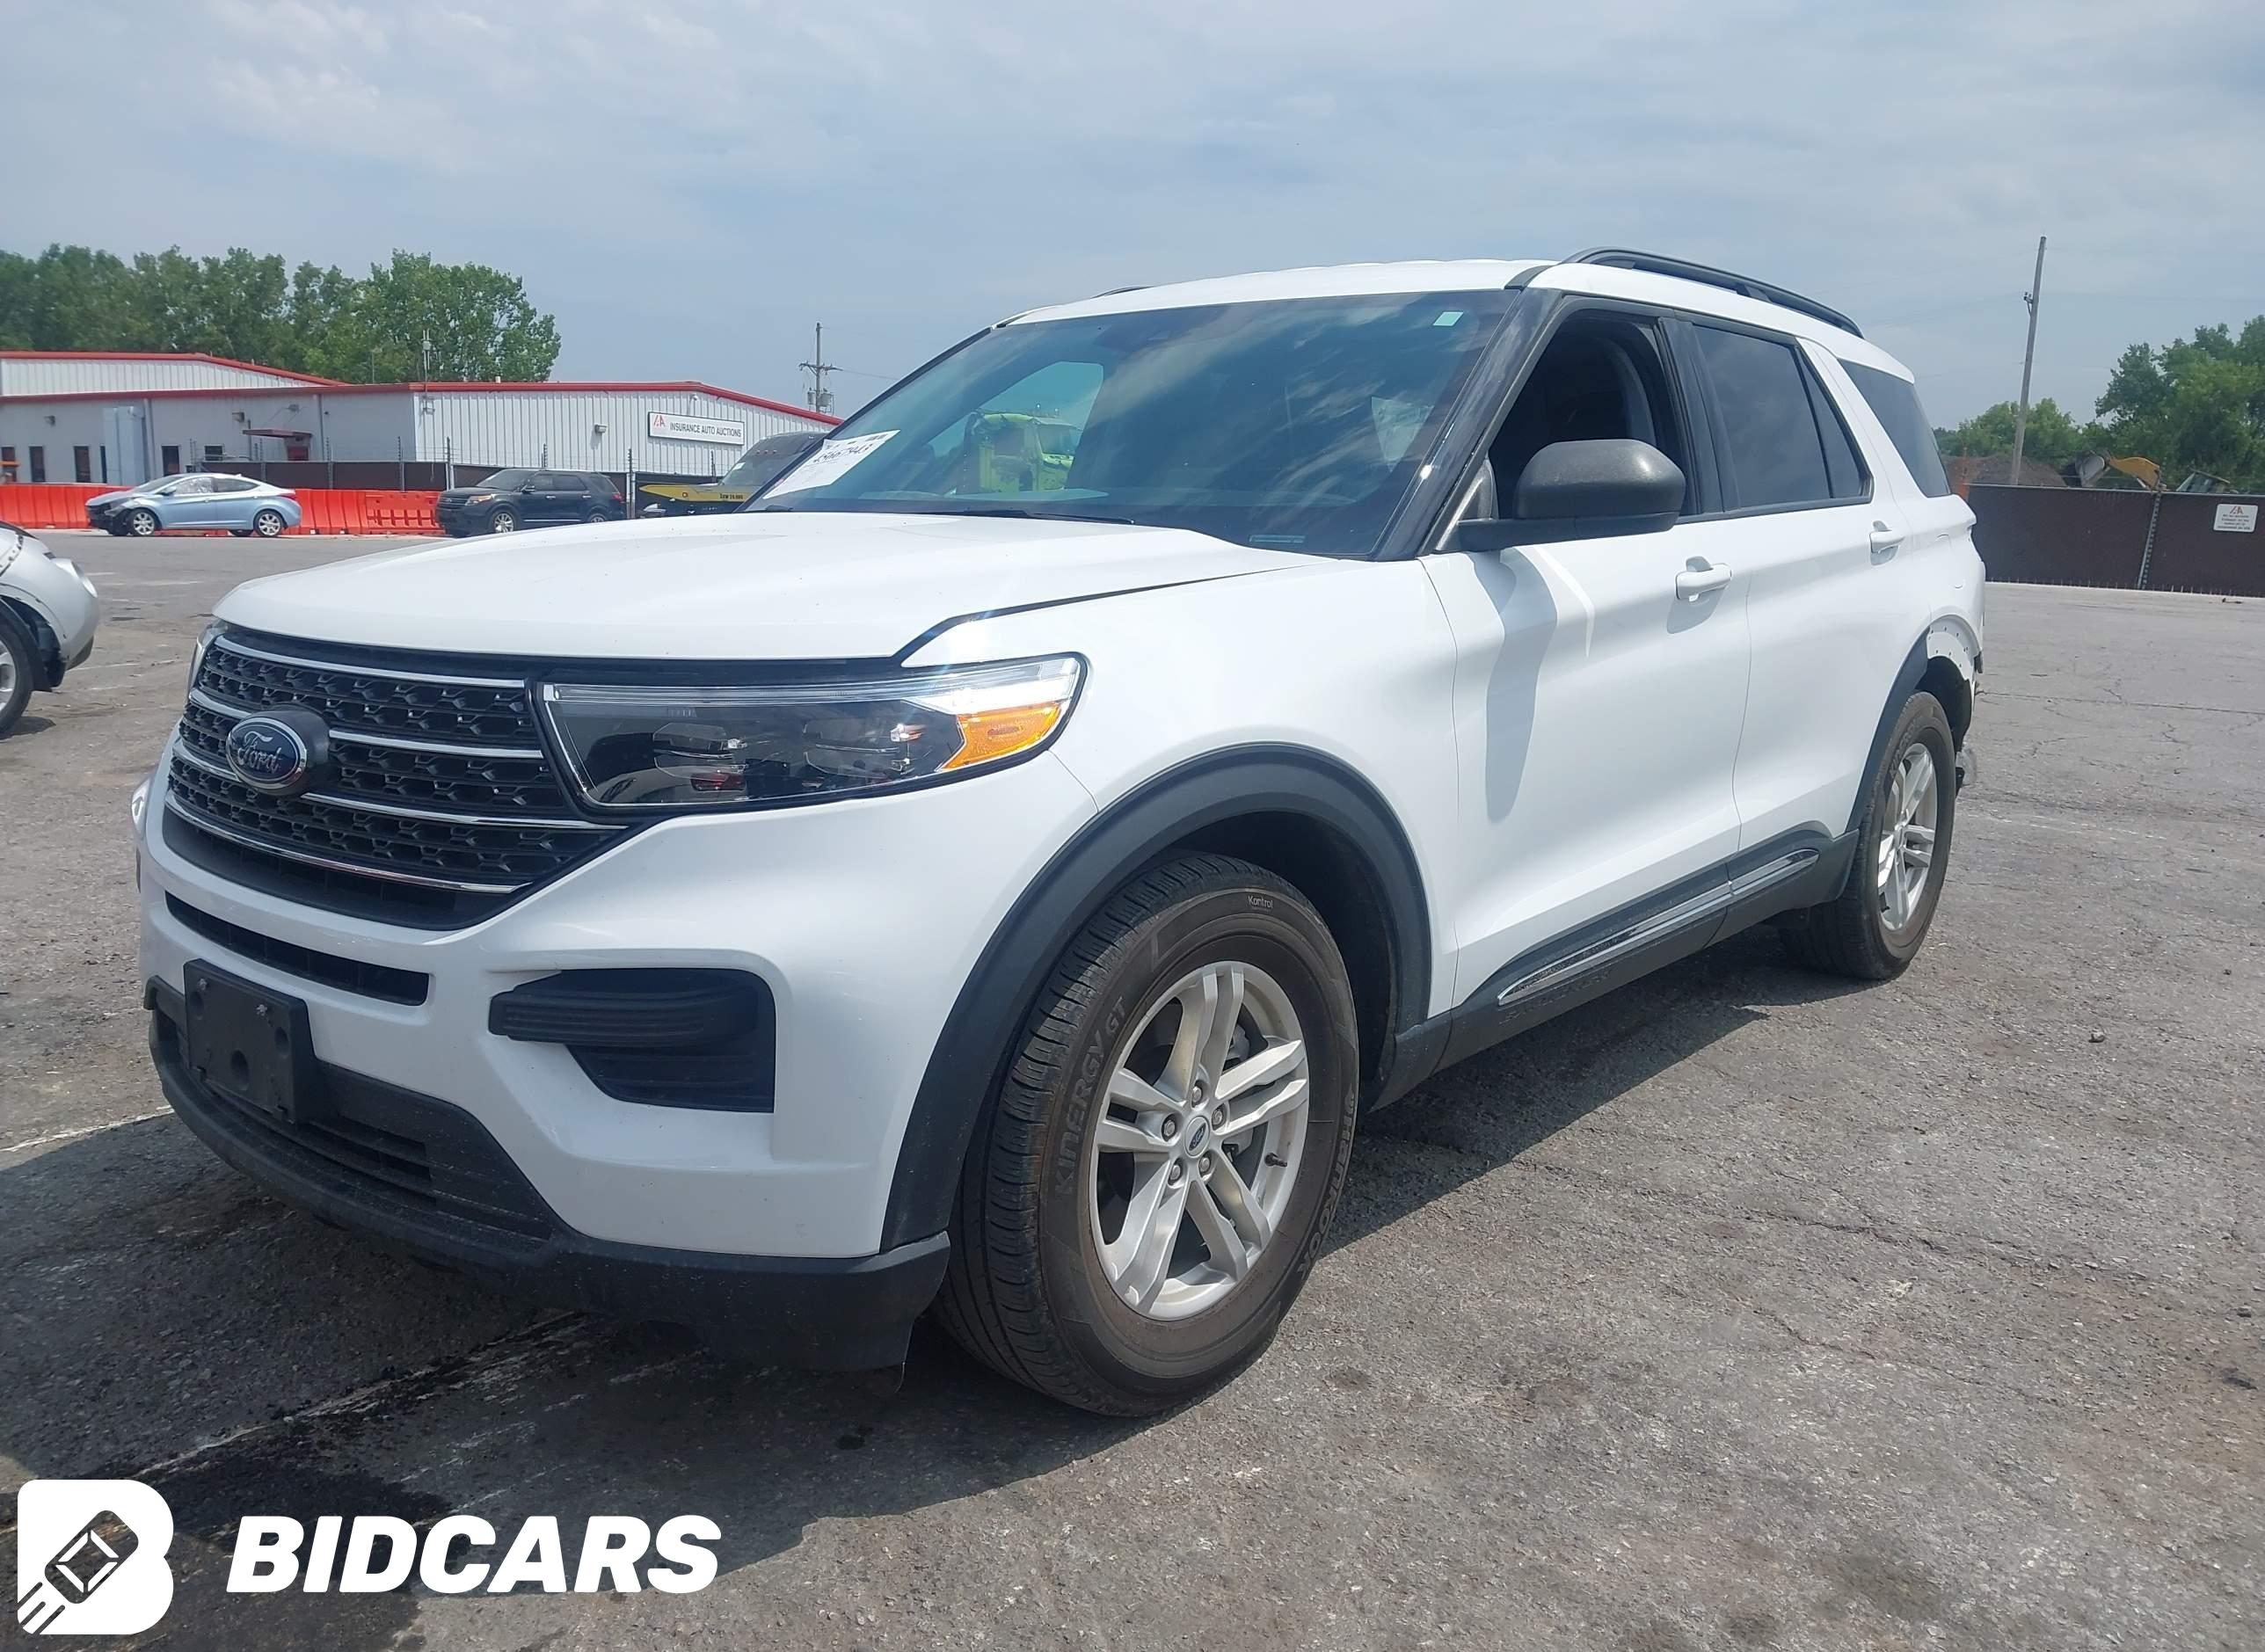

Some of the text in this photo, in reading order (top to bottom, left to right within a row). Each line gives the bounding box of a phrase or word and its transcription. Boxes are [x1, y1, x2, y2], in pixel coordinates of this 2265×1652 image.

[669, 422, 742, 438] INSURANCE AUTO AUCTIONS
[237, 731, 283, 774] Ford
[1248, 895, 1273, 908] Kontrol
[1105, 995, 1126, 1036] GT
